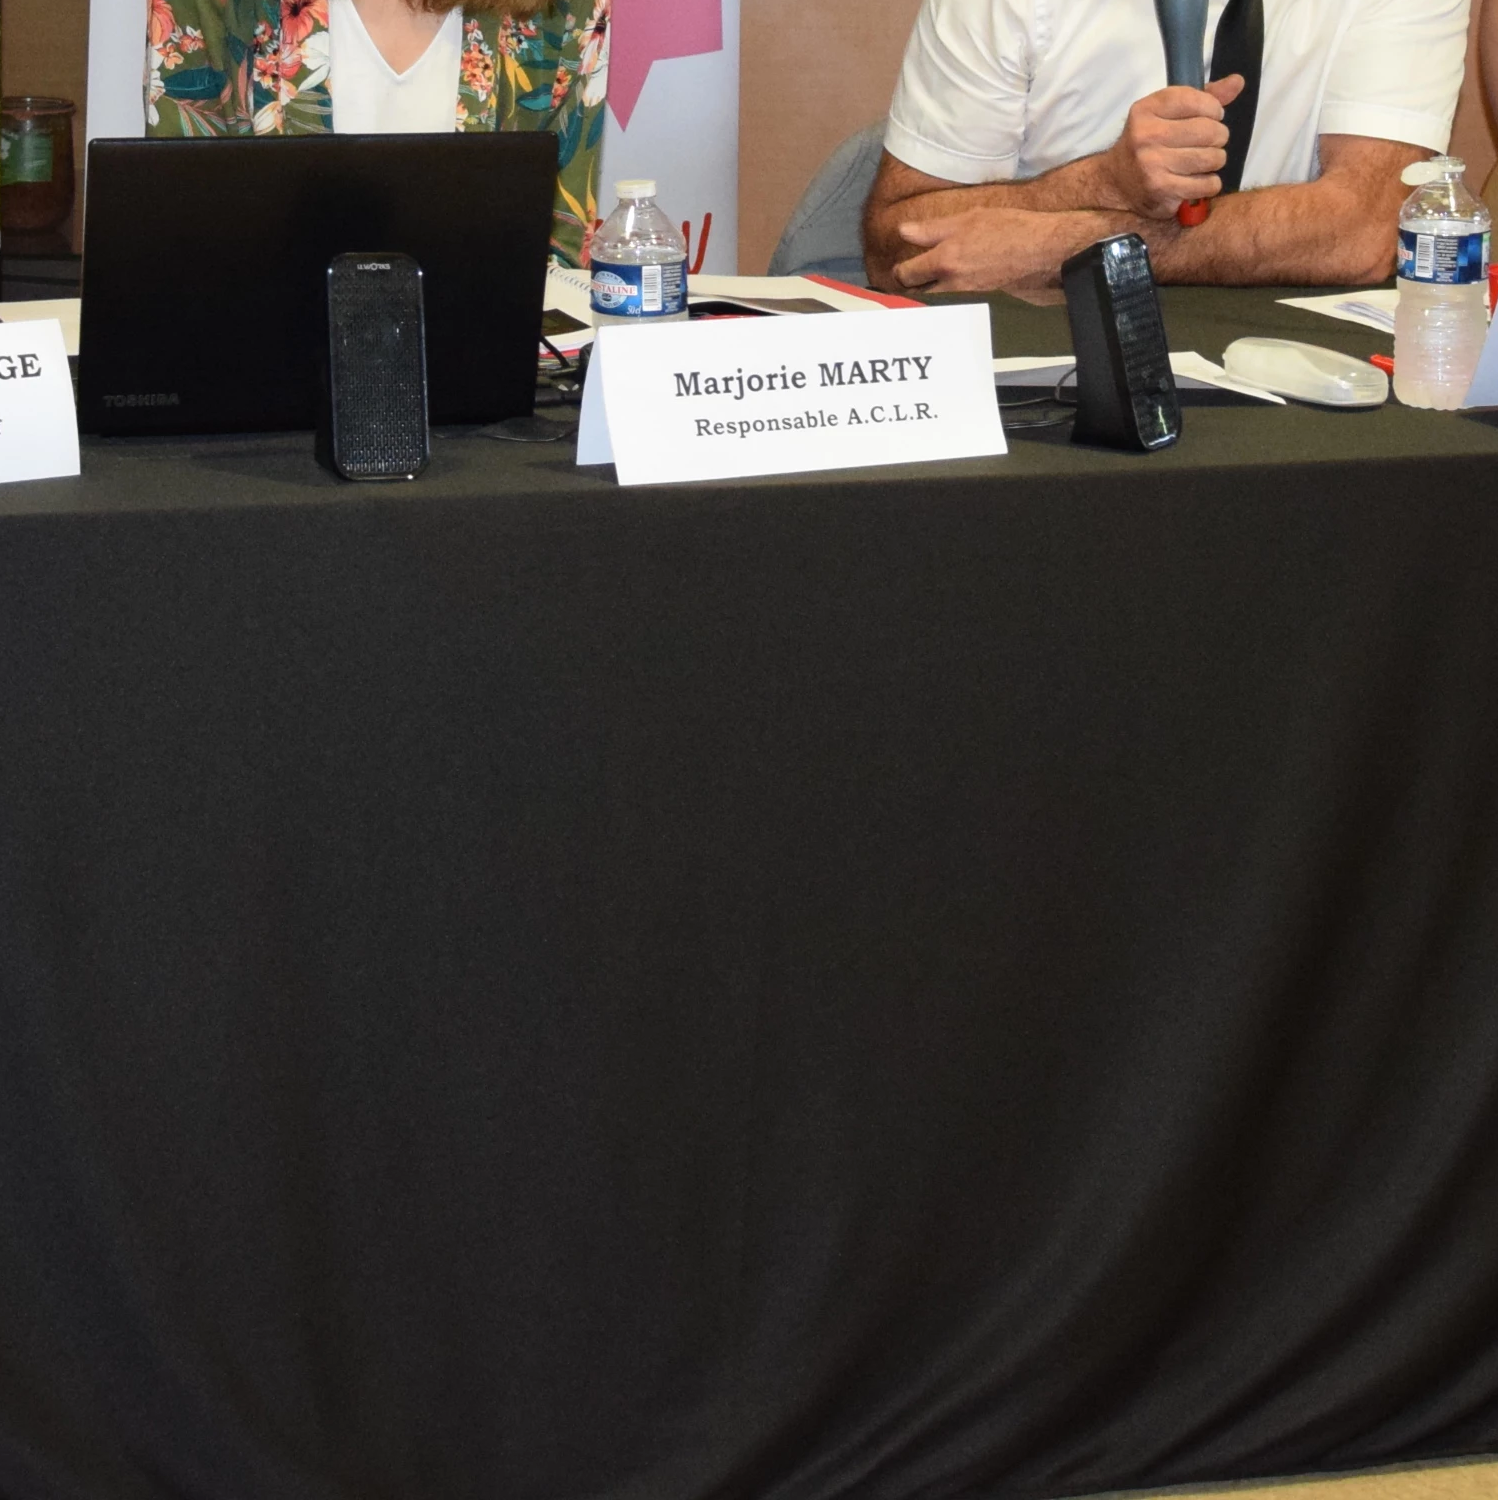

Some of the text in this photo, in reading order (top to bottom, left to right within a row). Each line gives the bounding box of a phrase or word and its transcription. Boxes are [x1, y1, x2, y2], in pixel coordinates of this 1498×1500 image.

[673, 356, 933, 400] Marjorie MARTY
[695, 402, 938, 438] Responsable A.C.L.R.
